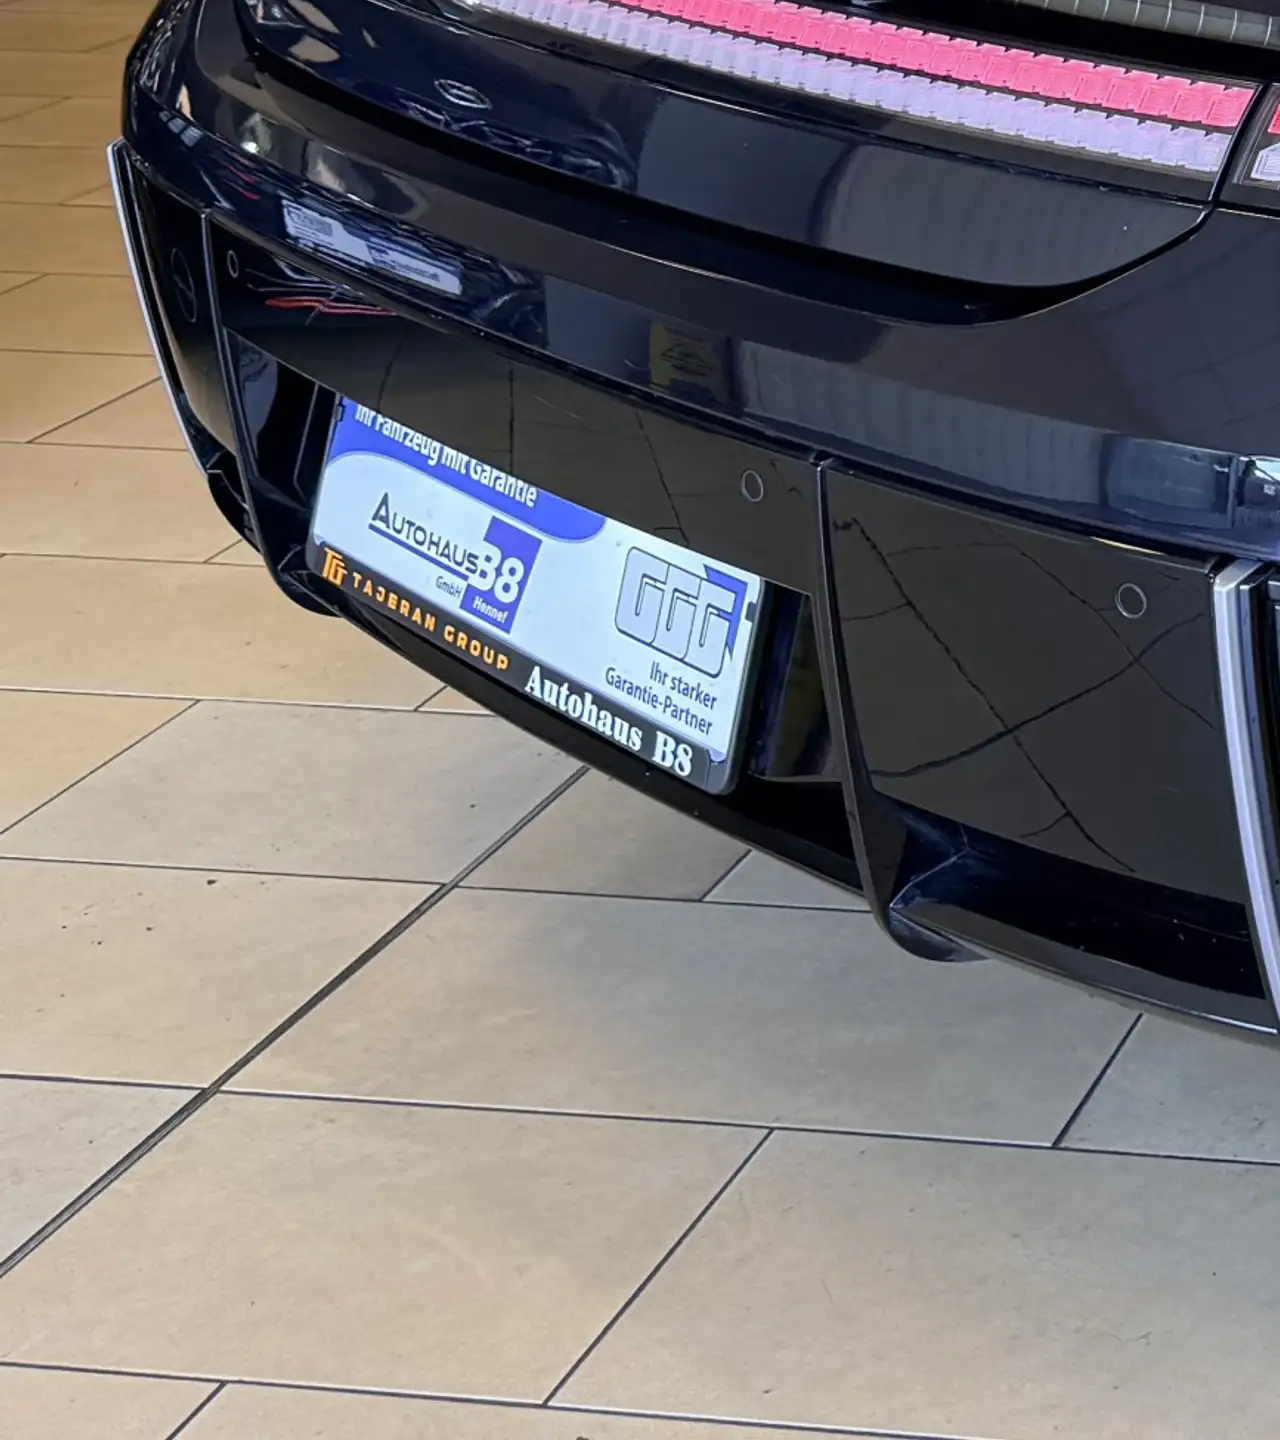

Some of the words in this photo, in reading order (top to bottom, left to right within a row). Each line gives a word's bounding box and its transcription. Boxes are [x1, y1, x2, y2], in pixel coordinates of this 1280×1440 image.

[355, 404, 375, 427] Ihr
[376, 413, 446, 467] Fahrzeug
[441, 447, 468, 475] mit
[470, 459, 539, 508] Garantie
[435, 575, 464, 600] GmbH
[466, 539, 525, 604] B8
[352, 571, 437, 633] TAJERAN
[443, 624, 510, 672] GROUP
[472, 595, 509, 624] Hennef
[605, 666, 713, 736] Garantie-Partner
[649, 660, 669, 686] Ihr
[671, 674, 718, 711] starker
[524, 665, 643, 752] Autohaus
[652, 730, 693, 777] B8
